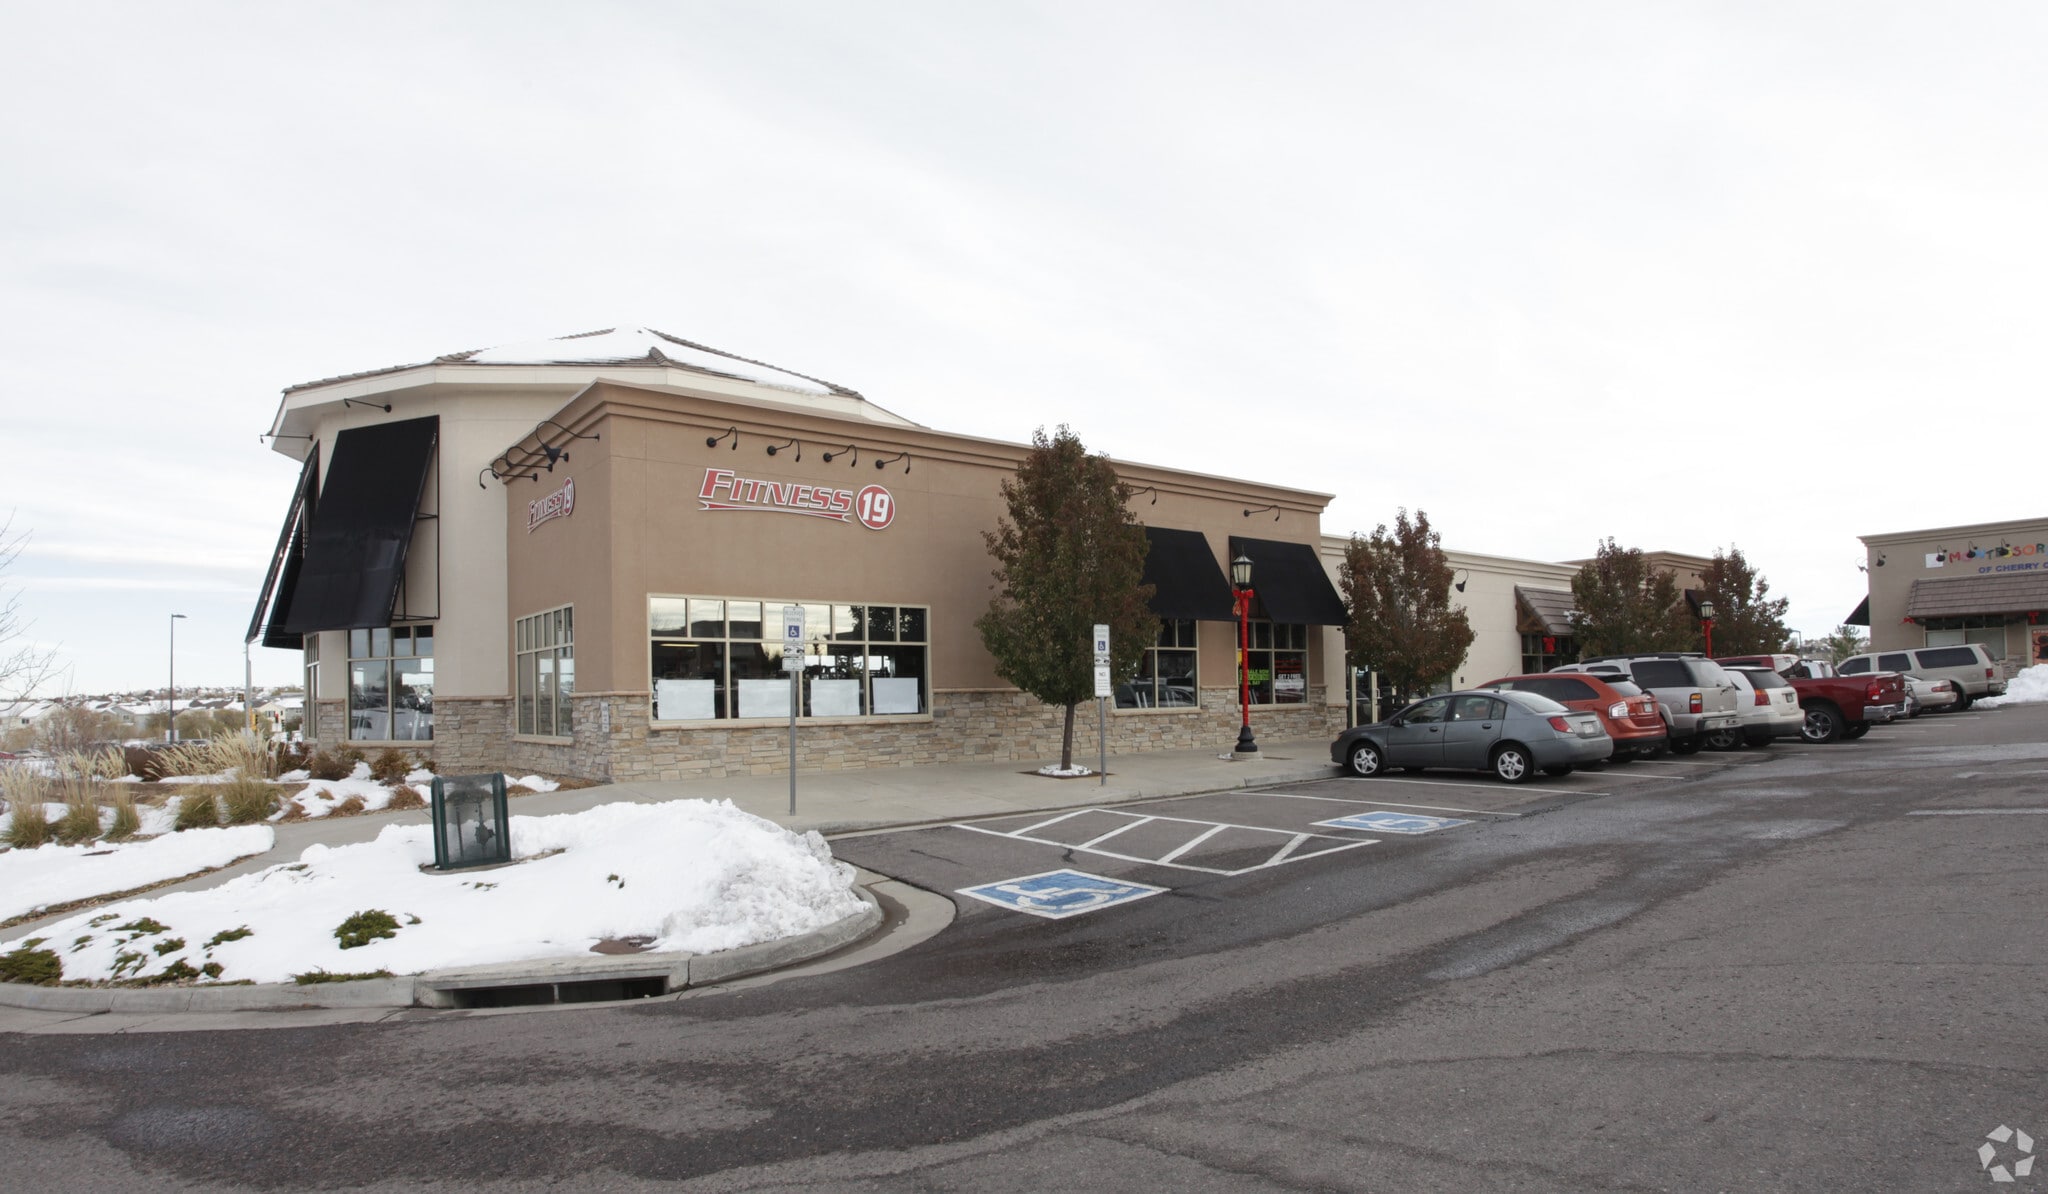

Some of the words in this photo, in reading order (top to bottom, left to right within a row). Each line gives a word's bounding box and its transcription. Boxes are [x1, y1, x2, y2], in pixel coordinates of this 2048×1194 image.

[527, 489, 563, 526] FITNESS
[698, 467, 854, 513] FITNESS
[861, 489, 891, 524] 19
[1978, 566, 1992, 574] OF
[1995, 562, 2039, 572] CHERRY
